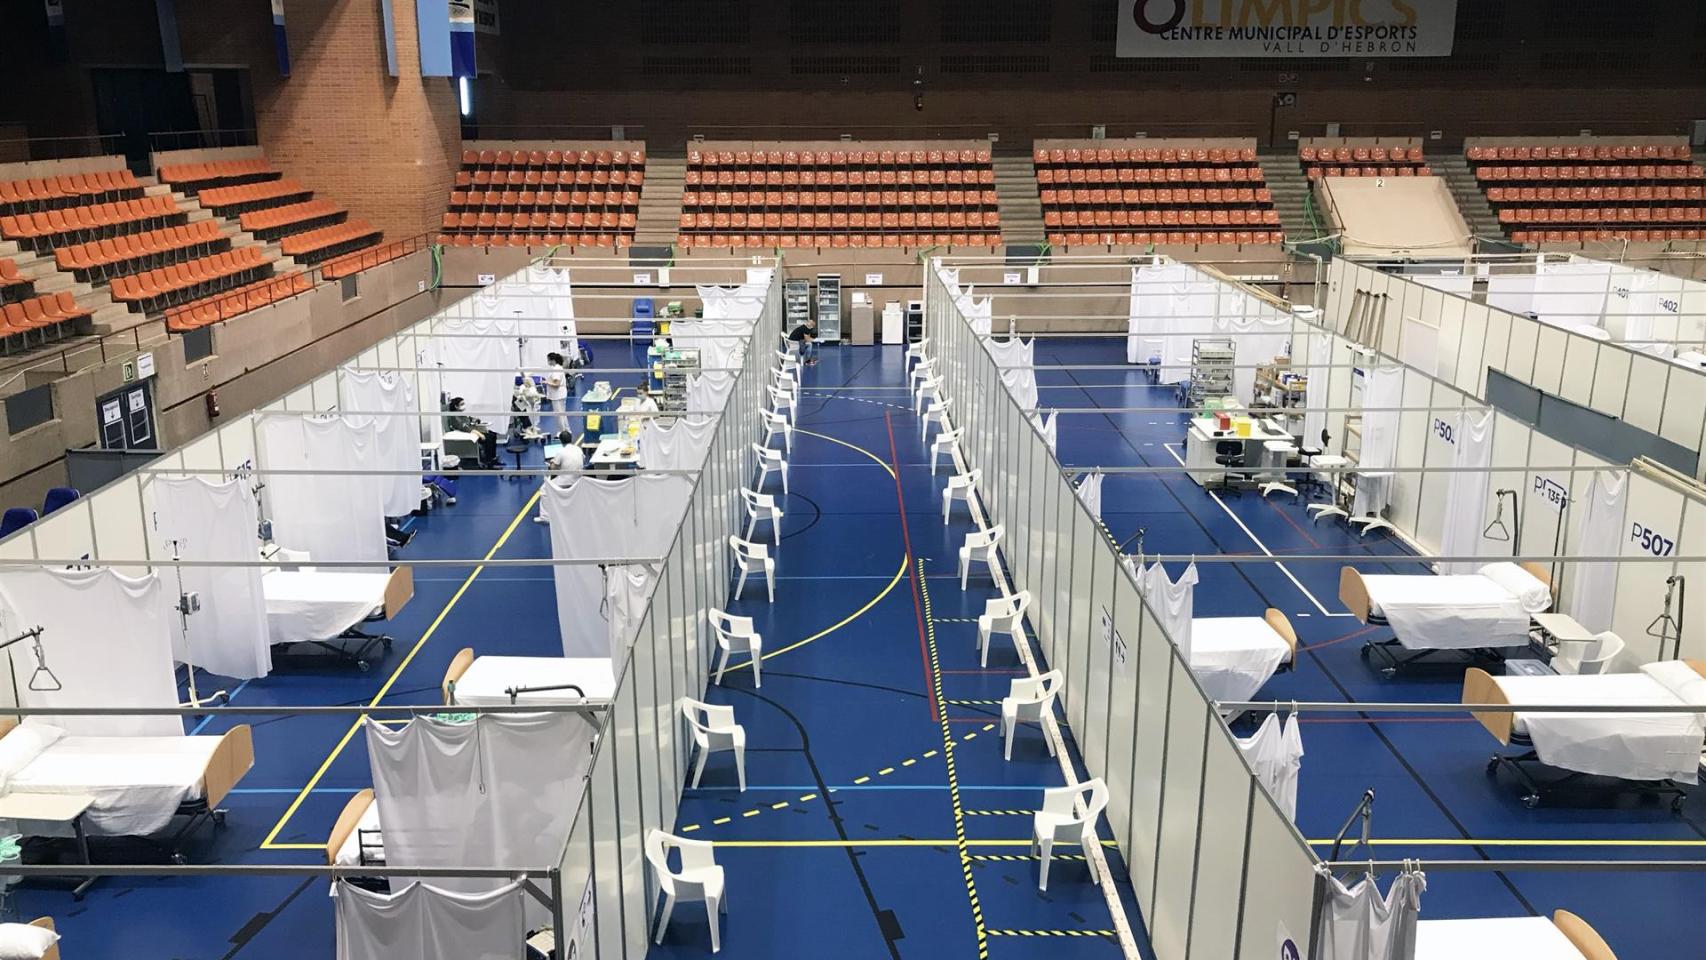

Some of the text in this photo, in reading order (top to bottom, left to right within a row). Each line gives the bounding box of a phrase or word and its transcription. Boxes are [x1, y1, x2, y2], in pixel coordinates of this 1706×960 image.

[1160, 25, 1418, 40] CENTRE MUNICIPAL D'ESPORTS
[1263, 42, 1416, 53] VALL D'HEBRON
[1377, 179, 1384, 188] 2
[1659, 298, 1678, 313] P402
[1433, 418, 1455, 445] P50
[1547, 487, 1560, 504] 135
[1630, 521, 1674, 557] P507
